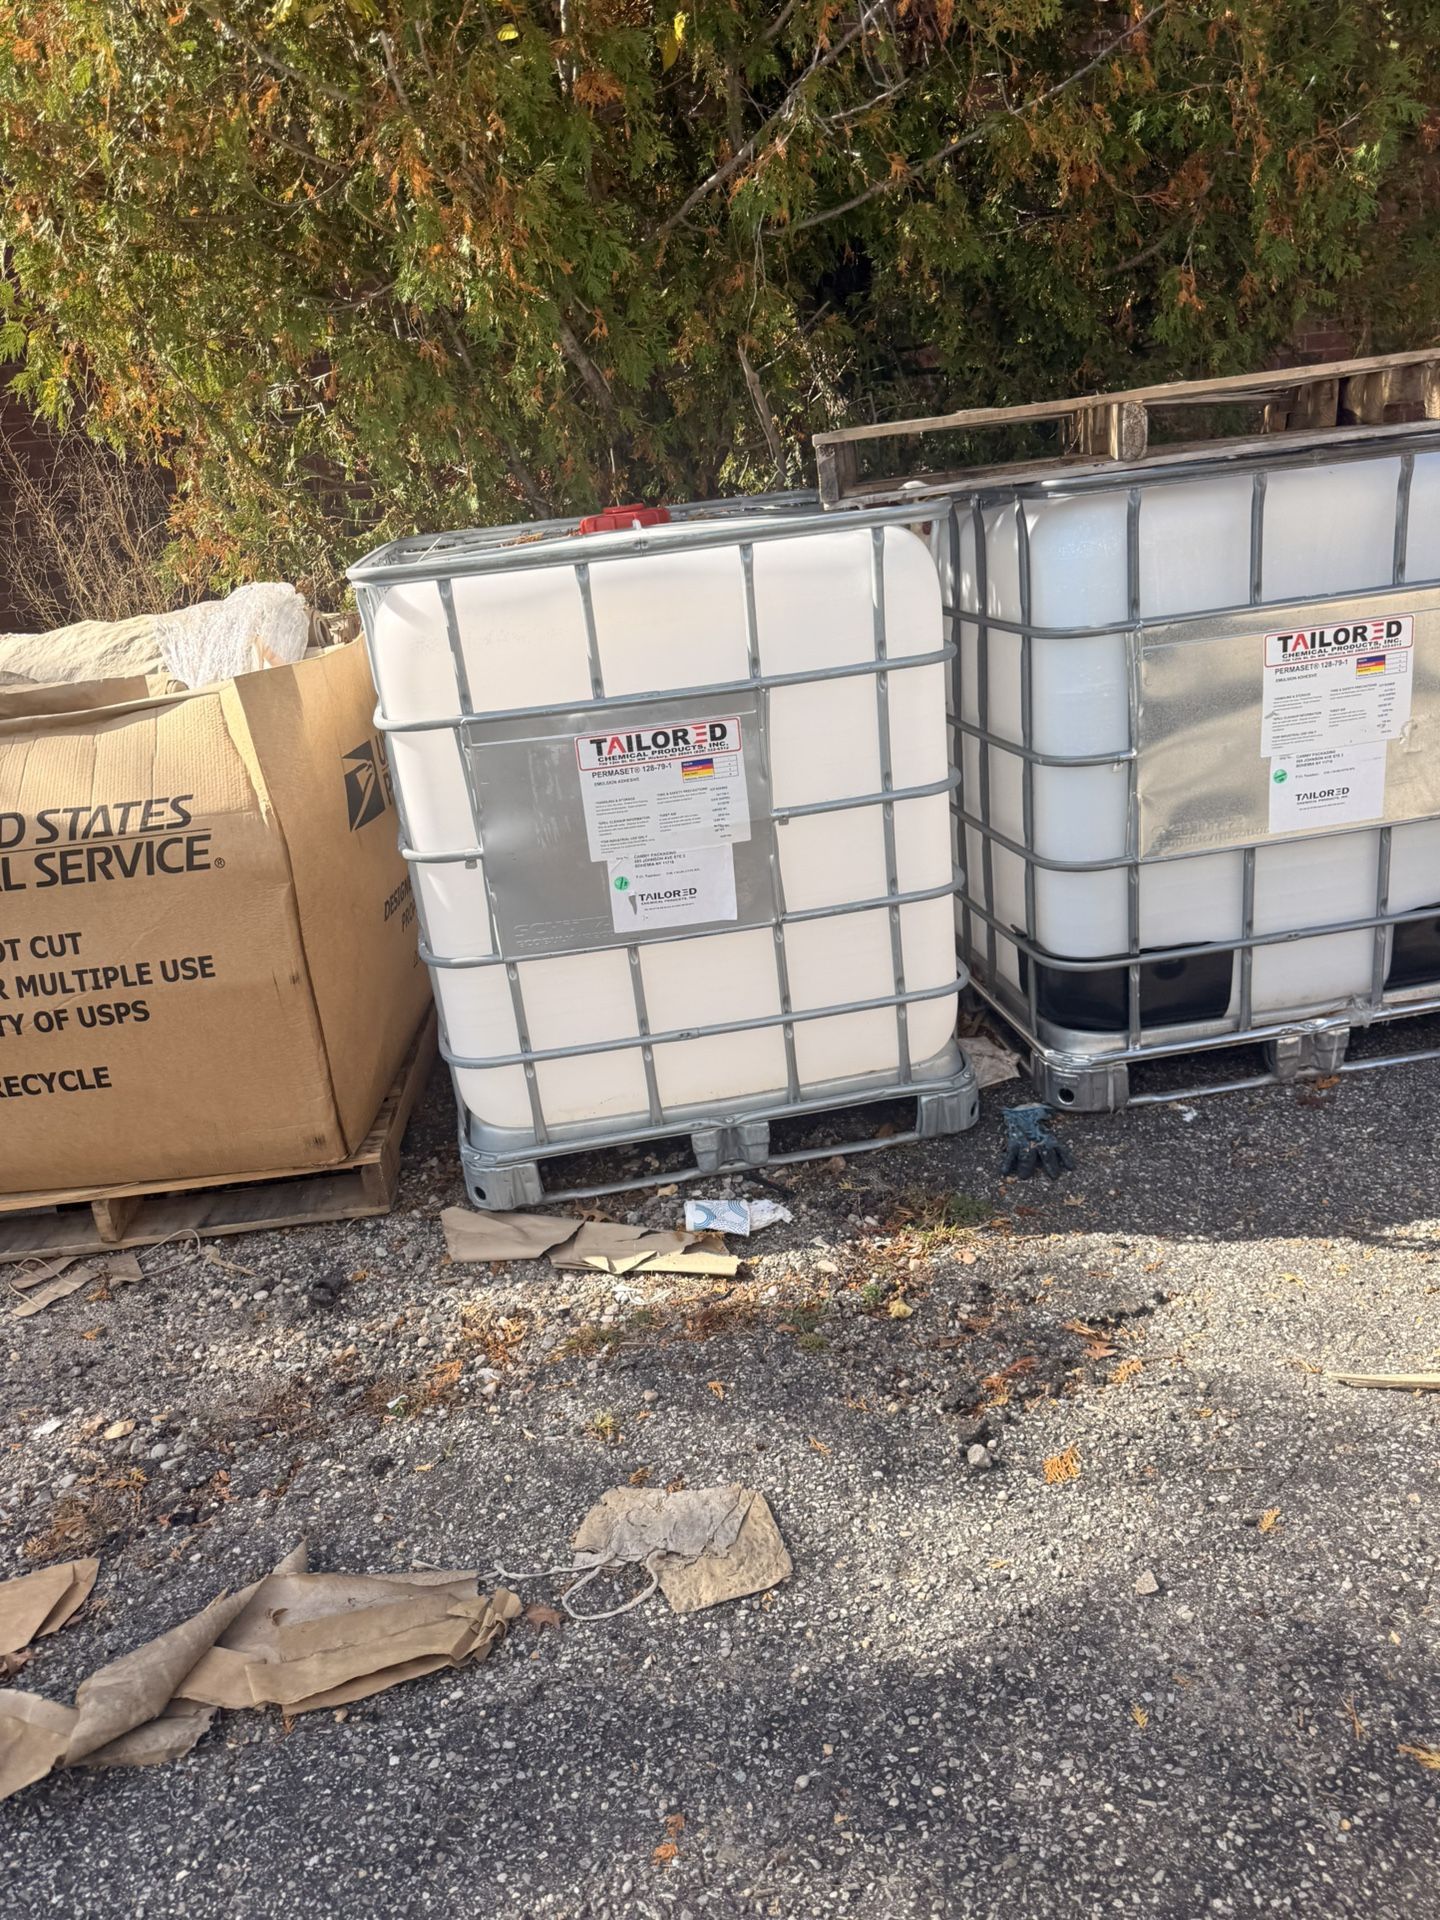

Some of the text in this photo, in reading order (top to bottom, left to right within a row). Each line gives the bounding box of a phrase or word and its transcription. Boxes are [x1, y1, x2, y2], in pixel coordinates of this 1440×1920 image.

[1277, 620, 1403, 653] TAILORED
[1282, 648, 1329, 660] CHEMICAL
[1331, 641, 1382, 652] PRODUCTS,
[1384, 637, 1402, 645] INC.
[1321, 659, 1348, 669] 128-79-1
[590, 723, 727, 756] TAILORED
[598, 740, 729, 763] CHEMICAL PRODUCTS, INC.
[642, 762, 673, 772] 128-79-1
[1295, 786, 1350, 802] TAILORED
[35, 794, 194, 845] STATES
[0, 857, 27, 892] L
[638, 887, 698, 902] TAILORED
[30, 932, 83, 959] CUT
[15, 962, 153, 999] MULTIPLE
[160, 955, 216, 983] USE
[34, 1008, 69, 1034] OF
[77, 999, 151, 1028] USPS
